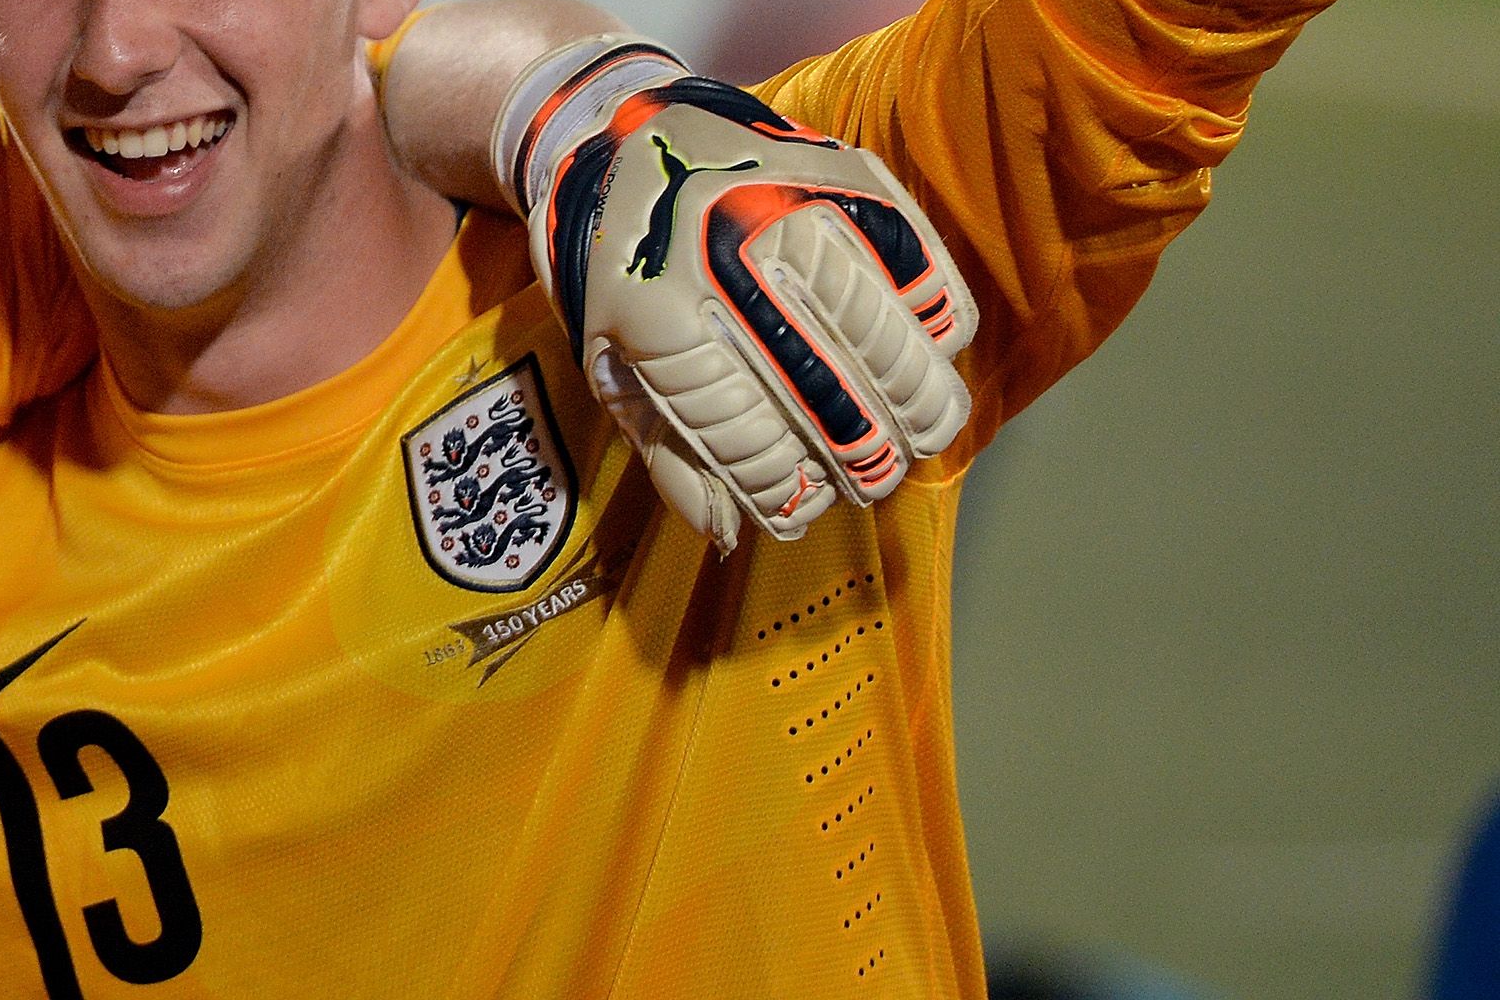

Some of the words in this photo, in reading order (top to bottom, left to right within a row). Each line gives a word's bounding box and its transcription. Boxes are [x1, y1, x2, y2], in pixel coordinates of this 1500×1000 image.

[482, 614, 525, 643] 150
[522, 578, 588, 626] YEARS
[423, 638, 467, 666] 1863
